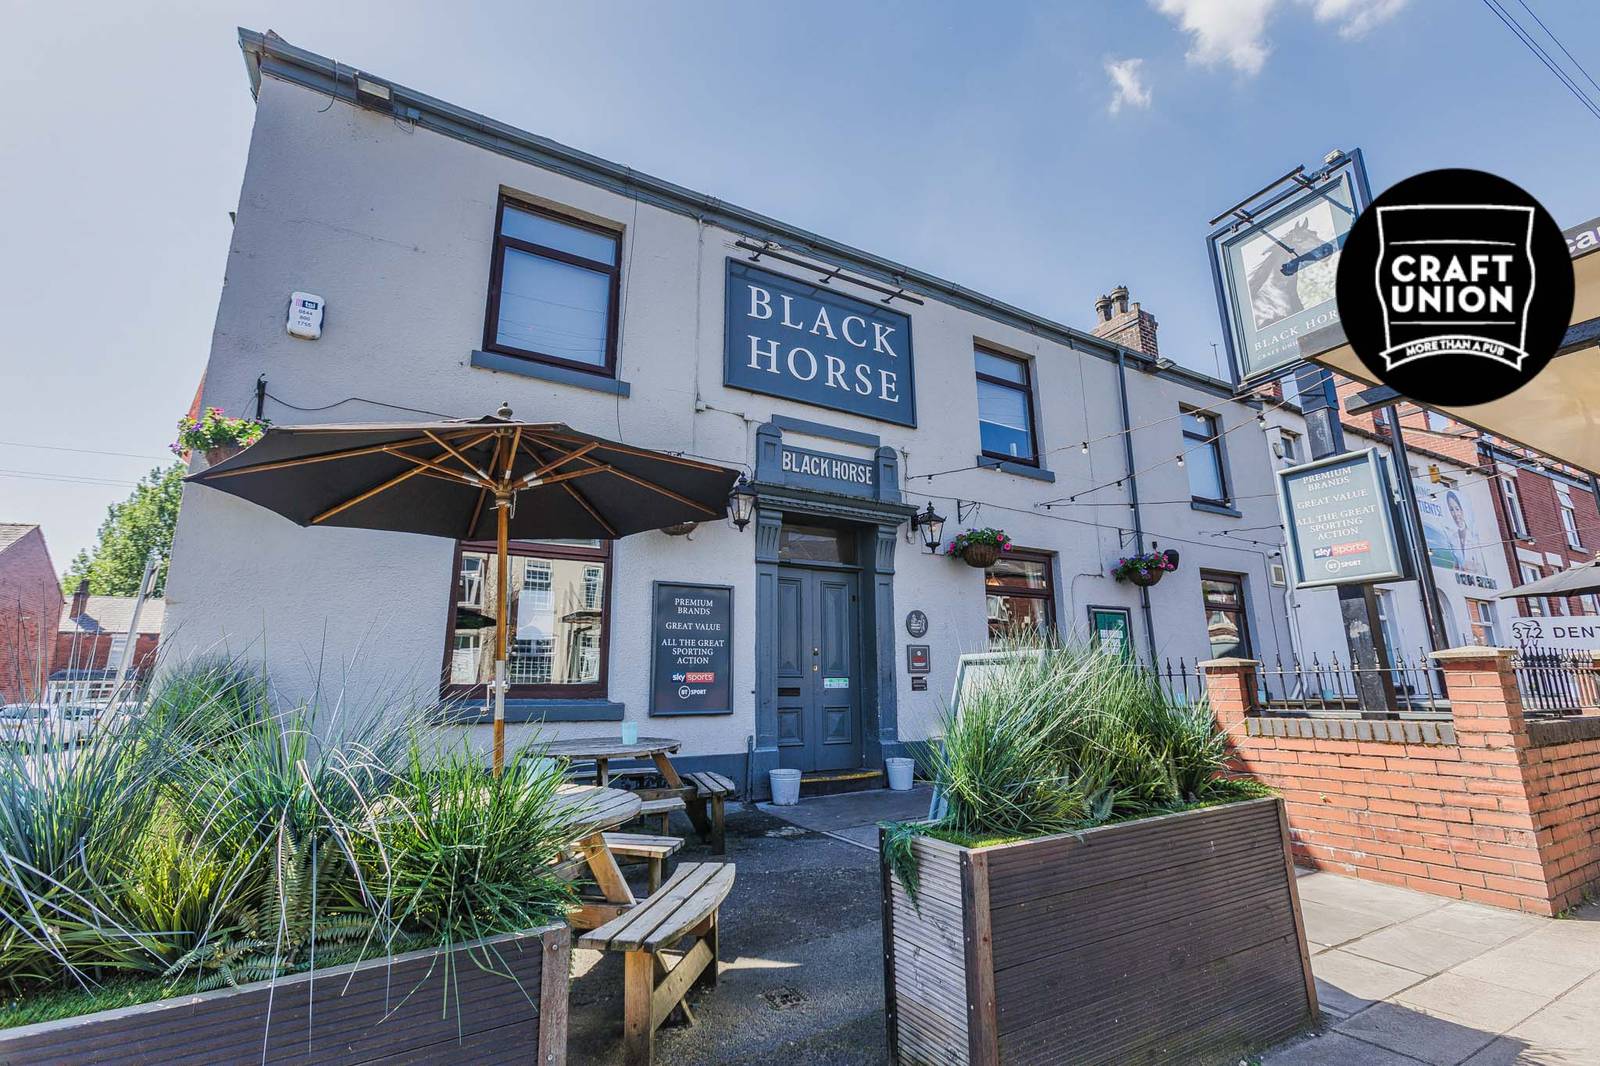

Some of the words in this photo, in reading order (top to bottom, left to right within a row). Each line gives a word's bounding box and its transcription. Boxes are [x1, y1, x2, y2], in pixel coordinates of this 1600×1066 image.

[747, 285, 897, 357] BLACK
[1254, 326, 1298, 351] BLACK
[1305, 309, 1338, 329] HOR
[747, 335, 899, 402] HORSE
[782, 451, 829, 478] BLACK
[832, 460, 873, 485] HORSE
[1303, 466, 1352, 484] PREMIUM
[1308, 476, 1350, 491] BRANDS
[1297, 497, 1330, 510] GREAT
[1333, 488, 1368, 502] VALUE
[1296, 517, 1316, 527] ALL
[1317, 511, 1338, 522] THE
[1341, 504, 1376, 518] GREAT
[1310, 517, 1363, 533] SPORTING
[1318, 526, 1359, 540] ACTION
[1314, 547, 1331, 558] sky
[1333, 542, 1368, 556] sports
[1340, 560, 1361, 568] SPORT
[674, 598, 713, 607] PREMIUM
[677, 606, 711, 615] BRANDS
[665, 622, 693, 630] GREAT
[695, 623, 721, 631] VALUE
[1512, 627, 1544, 639] 372
[661, 638, 677, 646] ALL
[679, 638, 696, 646] THE
[698, 639, 725, 647] GREAT
[672, 647, 713, 656] SPORTING
[677, 656, 709, 665] ACTION
[672, 673, 686, 682] sky
[687, 673, 713, 682] sports
